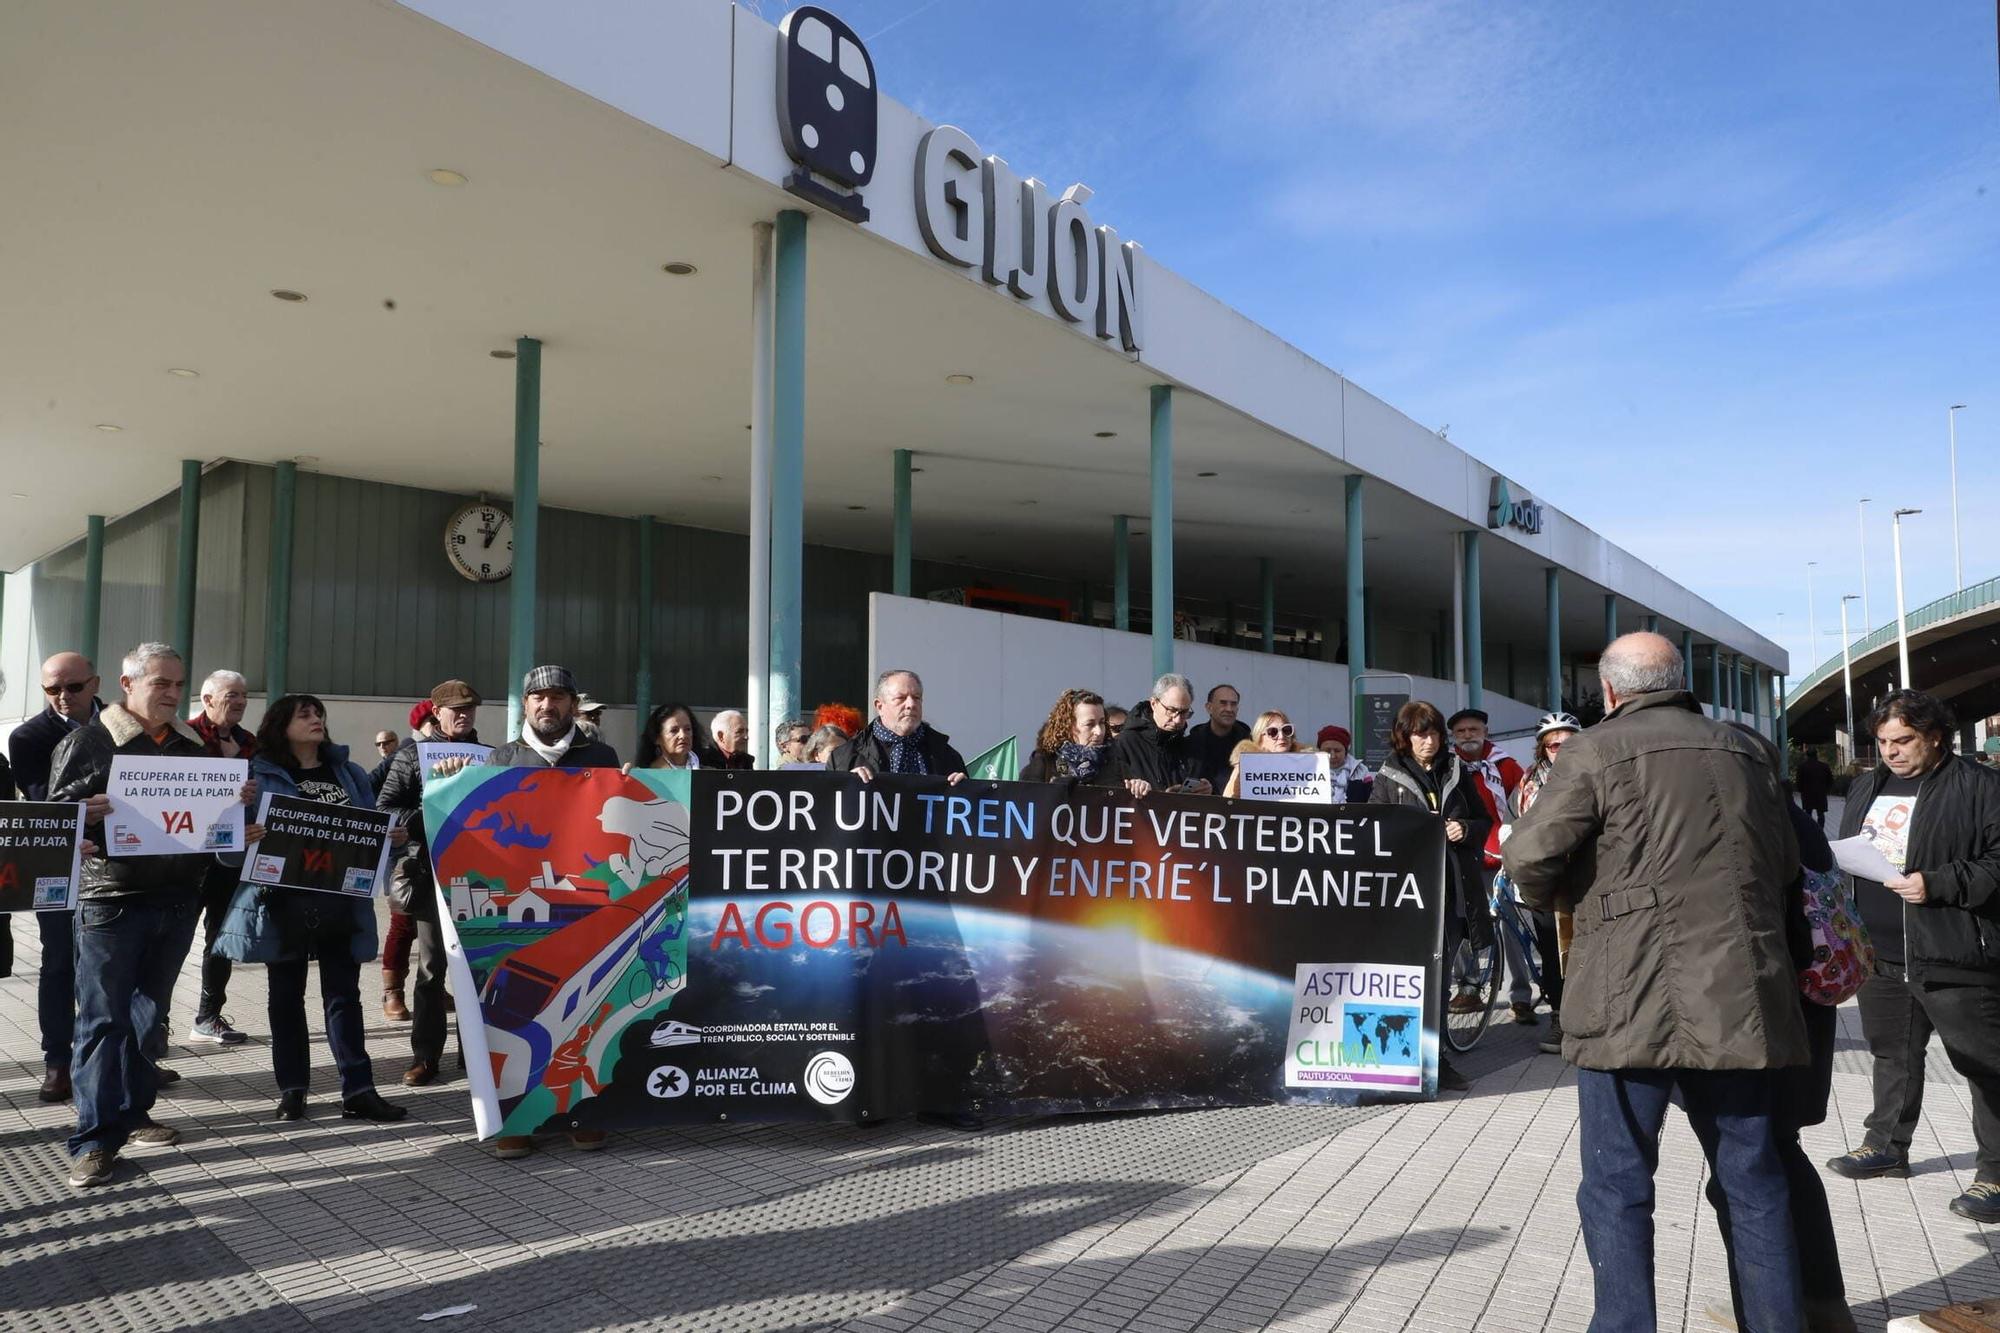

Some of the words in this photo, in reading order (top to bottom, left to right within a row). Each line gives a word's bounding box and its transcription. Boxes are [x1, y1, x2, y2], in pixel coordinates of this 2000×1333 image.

[914, 124, 1144, 353] GIJÓN
[481, 512, 495, 522] 12
[457, 534, 466, 545] 9
[481, 563, 490, 574] 6
[120, 771, 185, 782] RECUPERAR
[187, 773, 198, 782] EL
[201, 773, 227, 782] TREN
[229, 773, 240, 783] DE
[1245, 772, 1326, 782] EMERXENCIA
[125, 787, 138, 797] LA
[141, 787, 171, 797] RUTA
[174, 788, 188, 797] DE
[190, 788, 203, 797] LA
[206, 788, 234, 797] PLATA
[1252, 785, 1320, 796] CLIMÁTICA
[11, 818, 25, 829] EL
[28, 818, 59, 829] TREN
[62, 819, 77, 829] DE
[161, 811, 195, 834] YA
[269, 807, 330, 825] RECUPERAR
[332, 817, 343, 827] EL
[346, 820, 372, 831] TREN
[374, 824, 388, 834] DE
[716, 790, 816, 832] POR
[835, 790, 900, 832] UN
[917, 793, 1035, 840] TREN
[1051, 803, 1135, 847] QUE
[15, 836, 30, 847] LA
[33, 836, 68, 847] PLATA
[271, 822, 285, 833] LA
[287, 824, 314, 837] RUTA
[317, 829, 331, 839] DE
[333, 832, 345, 841] LA
[348, 834, 378, 847] PLATA
[303, 847, 333, 872] YA
[711, 848, 997, 894] TERRITORIU
[1012, 855, 1039, 896] Y
[1246, 866, 1425, 909] PLANETA
[711, 901, 908, 951] AGORA
[1303, 971, 1422, 1000] ASTURIES
[1300, 1006, 1333, 1024] POL
[703, 1024, 772, 1033] COORDINADORA
[774, 1023, 809, 1032] ESTATAL
[810, 1023, 827, 1031] POR
[828, 1022, 839, 1031] EL
[702, 1035, 724, 1043] TREN
[726, 1033, 765, 1043] PÚBLICO,
[766, 1033, 798, 1042] SOCIAL
[799, 1033, 805, 1041] Y
[806, 1033, 856, 1041] SOSTENIBLE
[1296, 1040, 1380, 1069] CLIMA
[696, 1066, 759, 1081] ALIANZA
[1325, 1072, 1354, 1082] SOCIAL
[695, 1084, 725, 1097] POR
[730, 1083, 747, 1096] EL
[750, 1081, 797, 1096] CLIMA
